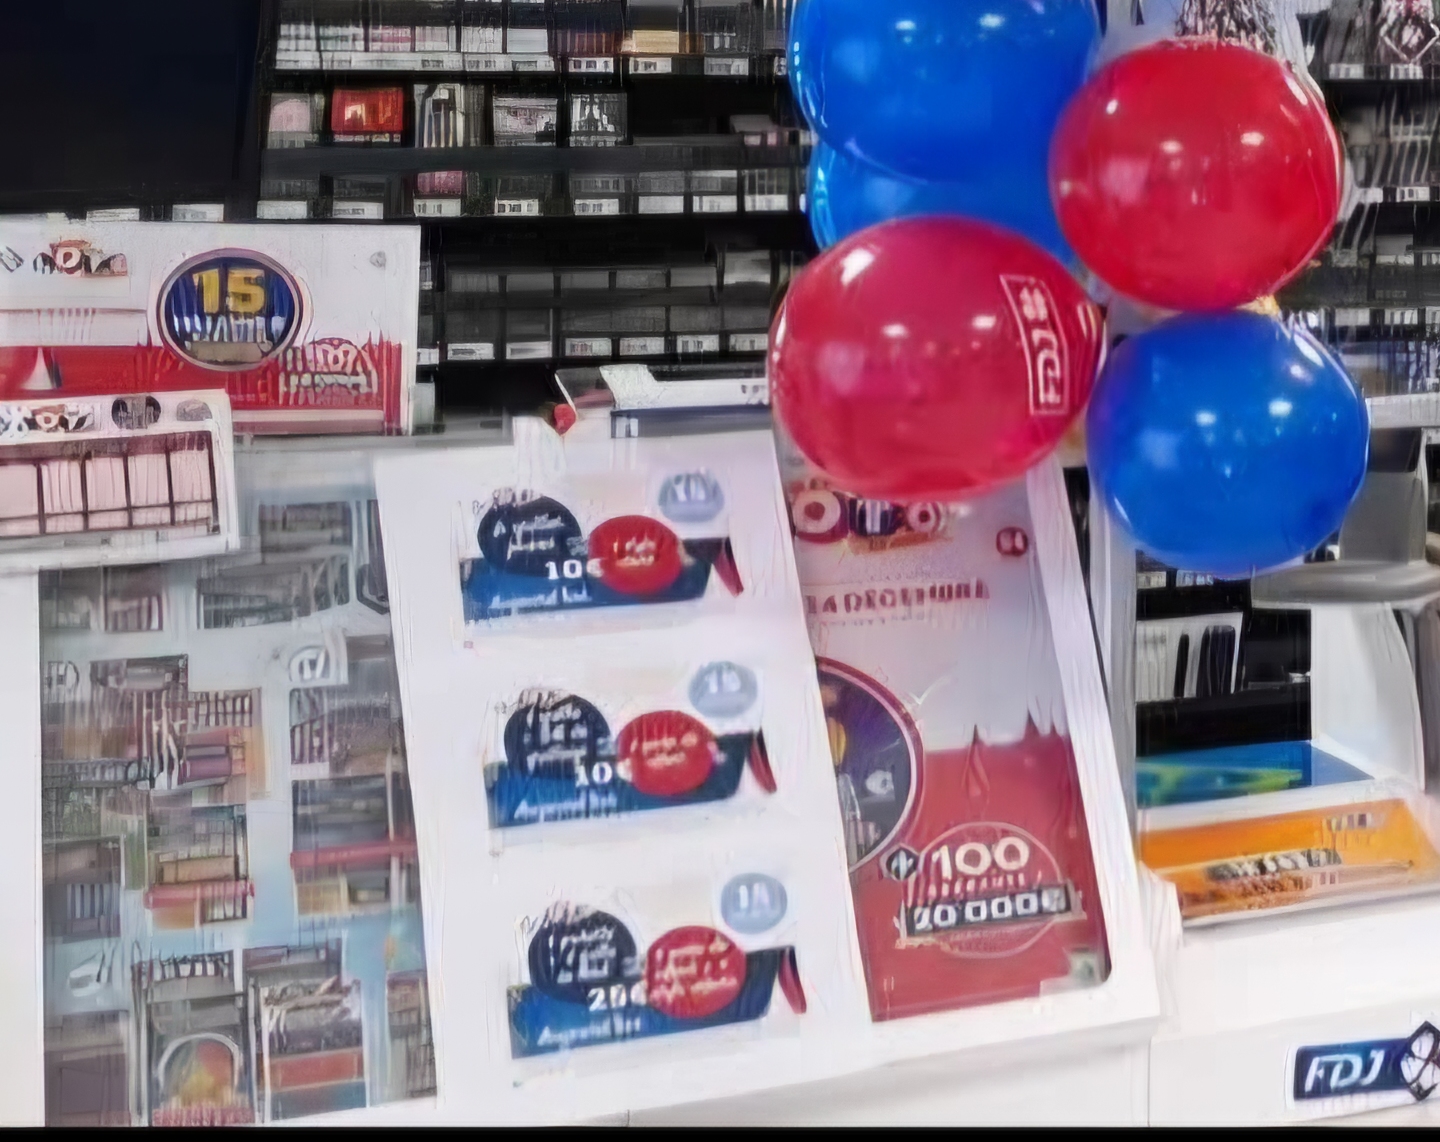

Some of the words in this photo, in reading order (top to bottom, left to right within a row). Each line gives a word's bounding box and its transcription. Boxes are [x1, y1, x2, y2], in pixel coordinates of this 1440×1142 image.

[192, 268, 267, 315] 15
[931, 836, 1030, 881] 100
[1304, 1048, 1386, 1093] FDJ
